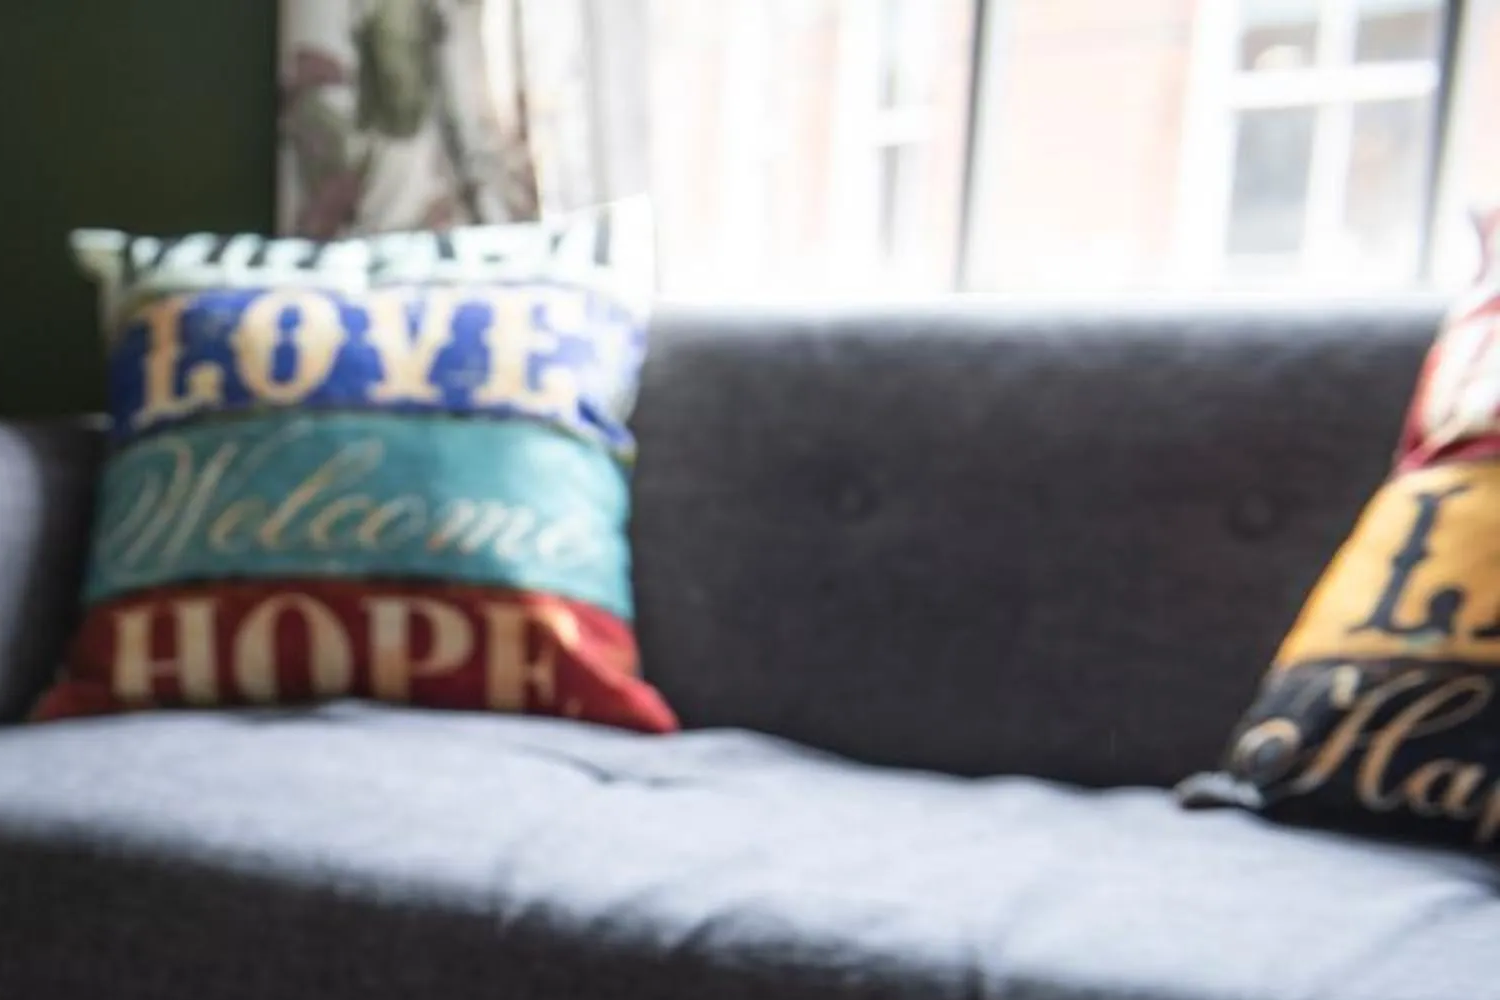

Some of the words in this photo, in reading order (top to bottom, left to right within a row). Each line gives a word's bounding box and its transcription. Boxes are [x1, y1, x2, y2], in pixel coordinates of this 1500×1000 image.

[132, 284, 585, 430] LOVE
[100, 424, 606, 585] Welcome
[112, 593, 570, 711] HOPE
